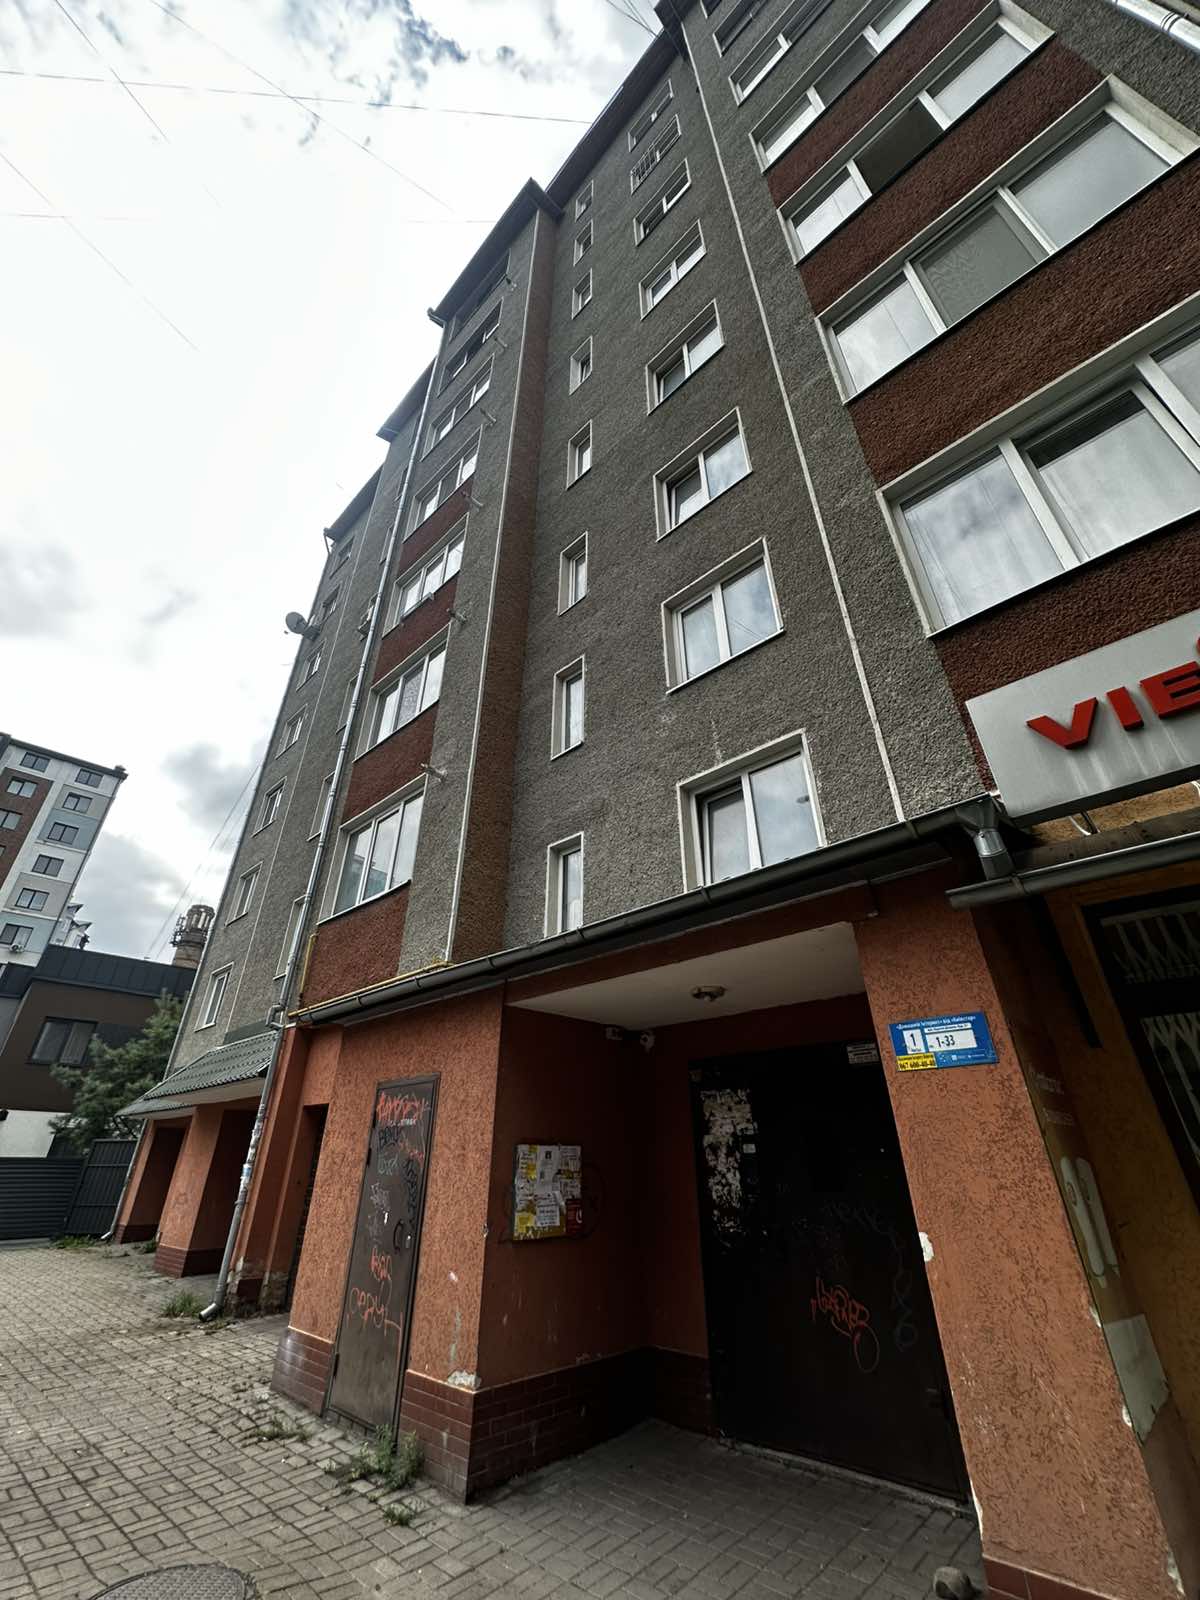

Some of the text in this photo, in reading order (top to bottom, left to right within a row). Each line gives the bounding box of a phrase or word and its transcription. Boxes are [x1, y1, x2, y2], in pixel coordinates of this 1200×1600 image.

[1026, 638, 1200, 750] VIE
[910, 1033, 917, 1047] 1
[936, 1035, 955, 1048] 1-33
